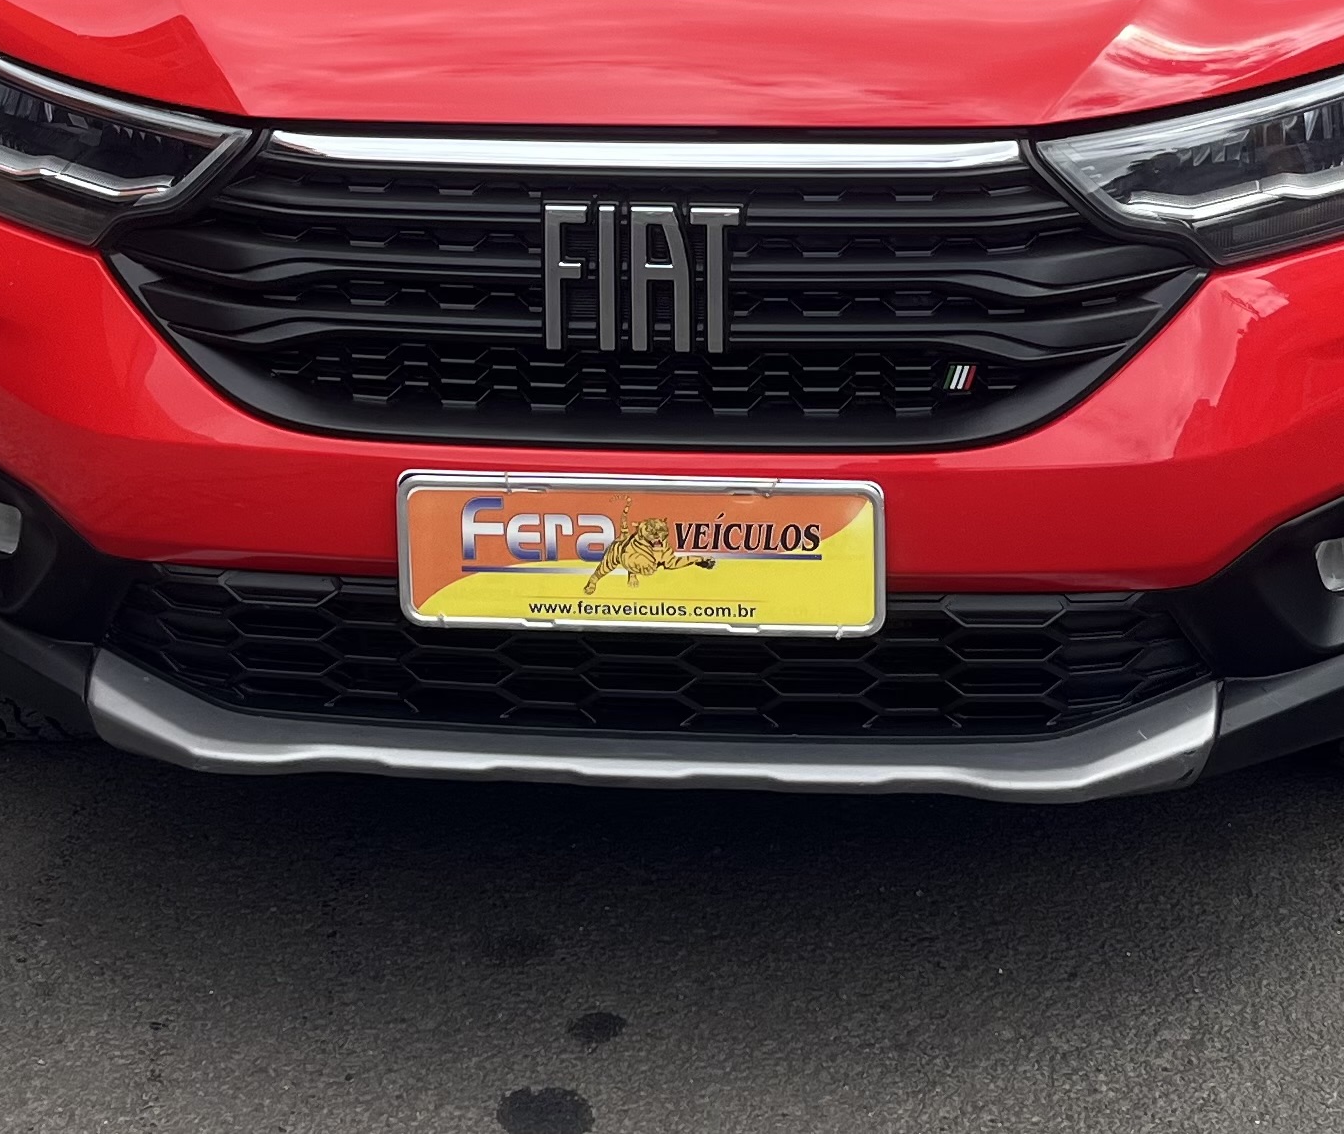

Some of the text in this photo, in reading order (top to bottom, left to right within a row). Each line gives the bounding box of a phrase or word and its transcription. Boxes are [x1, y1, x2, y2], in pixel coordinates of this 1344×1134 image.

[544, 203, 742, 353] FIAT
[461, 496, 822, 563] Fera VEÍCULOS
[528, 601, 757, 619] www.feraveiculos.com.br
